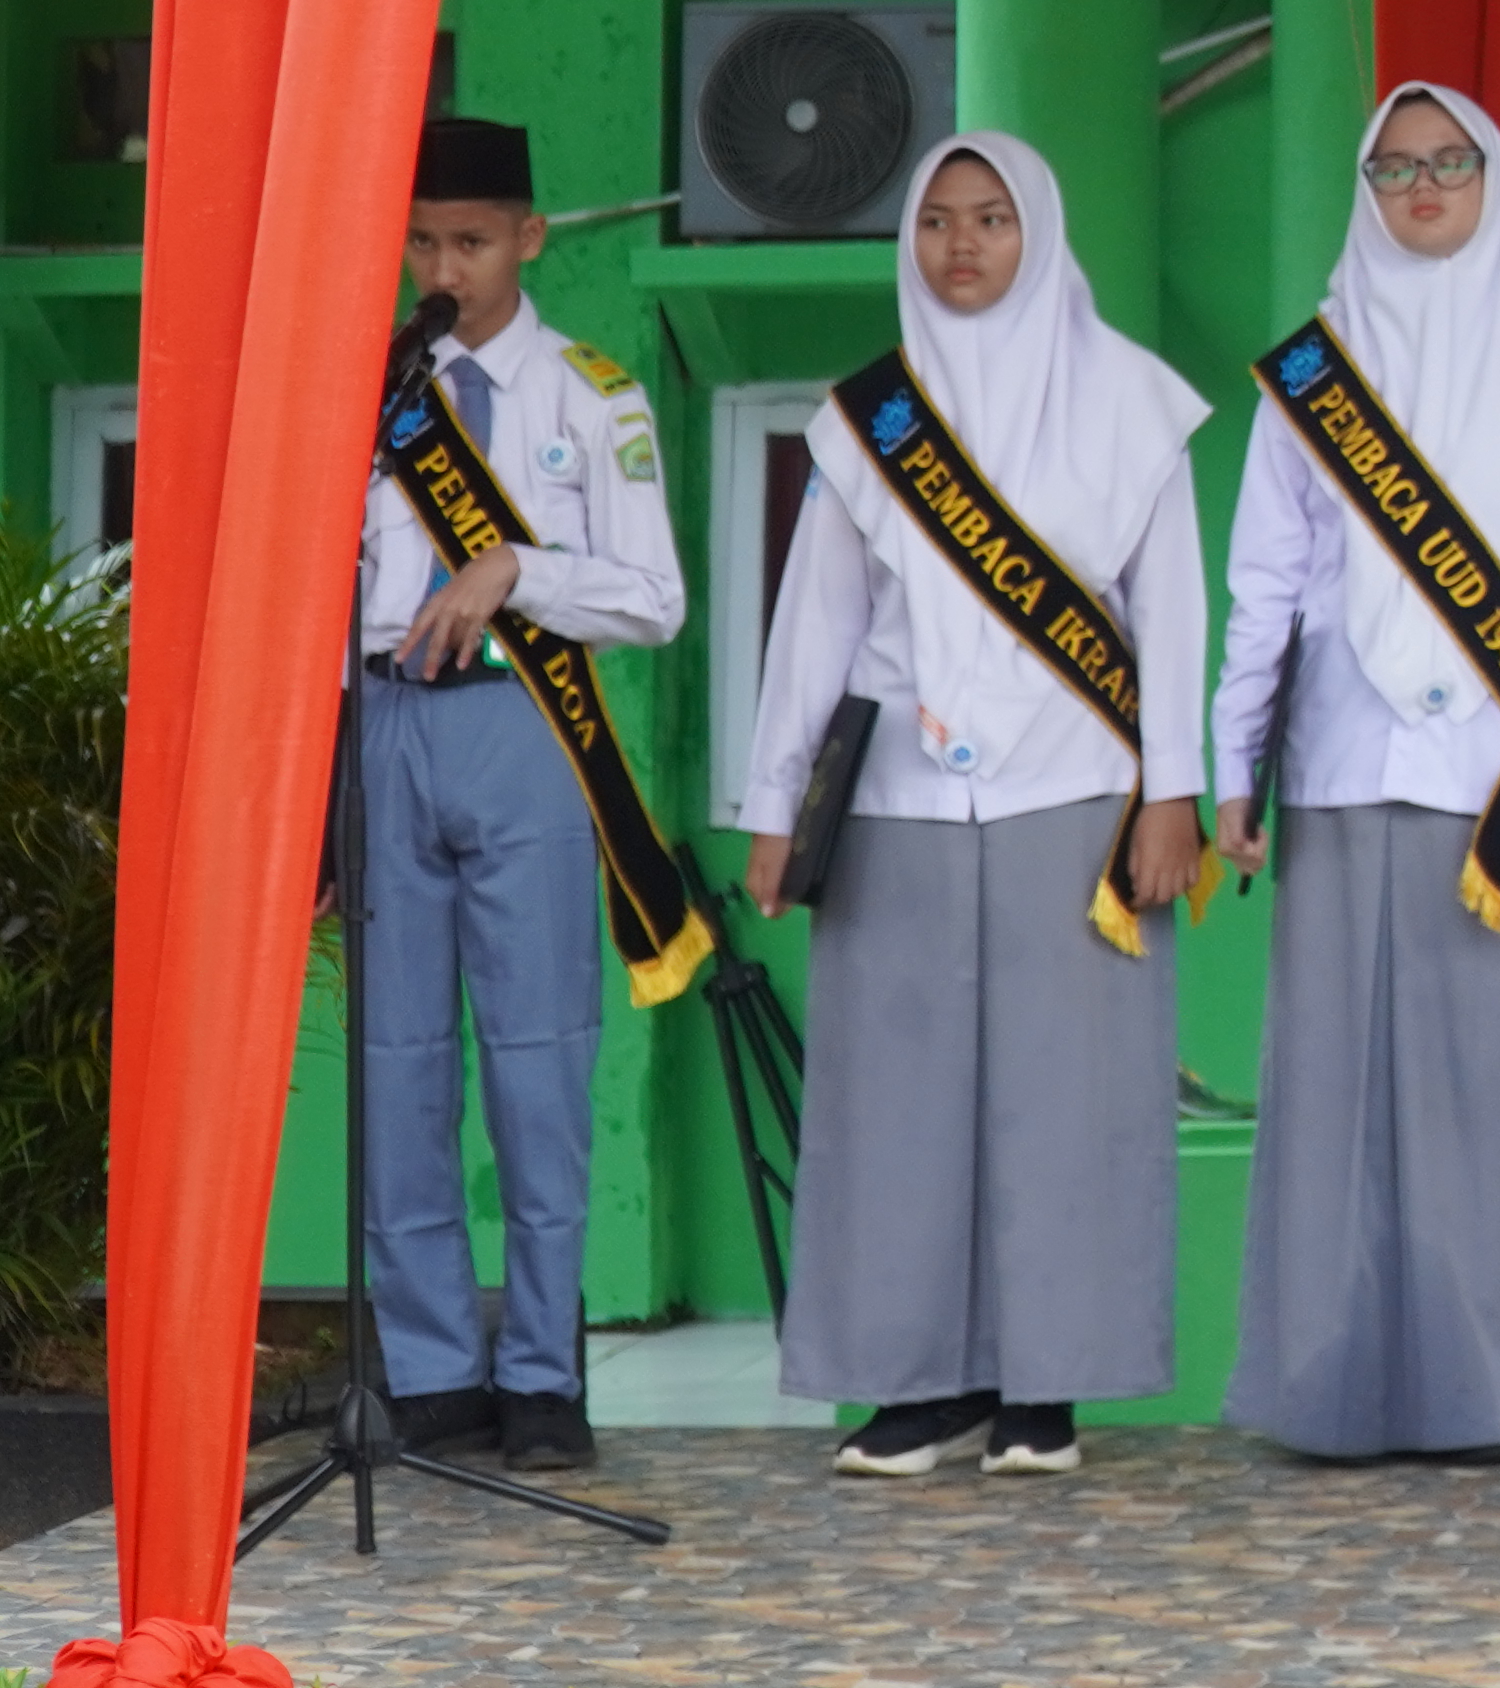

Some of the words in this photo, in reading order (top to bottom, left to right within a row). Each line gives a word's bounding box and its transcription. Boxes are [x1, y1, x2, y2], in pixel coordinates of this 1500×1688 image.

[901, 440, 1047, 616] PEMBACA
[1308, 382, 1431, 536] PEMBACA
[1418, 527, 1488, 609] UUD
[542, 648, 599, 753] DOA
